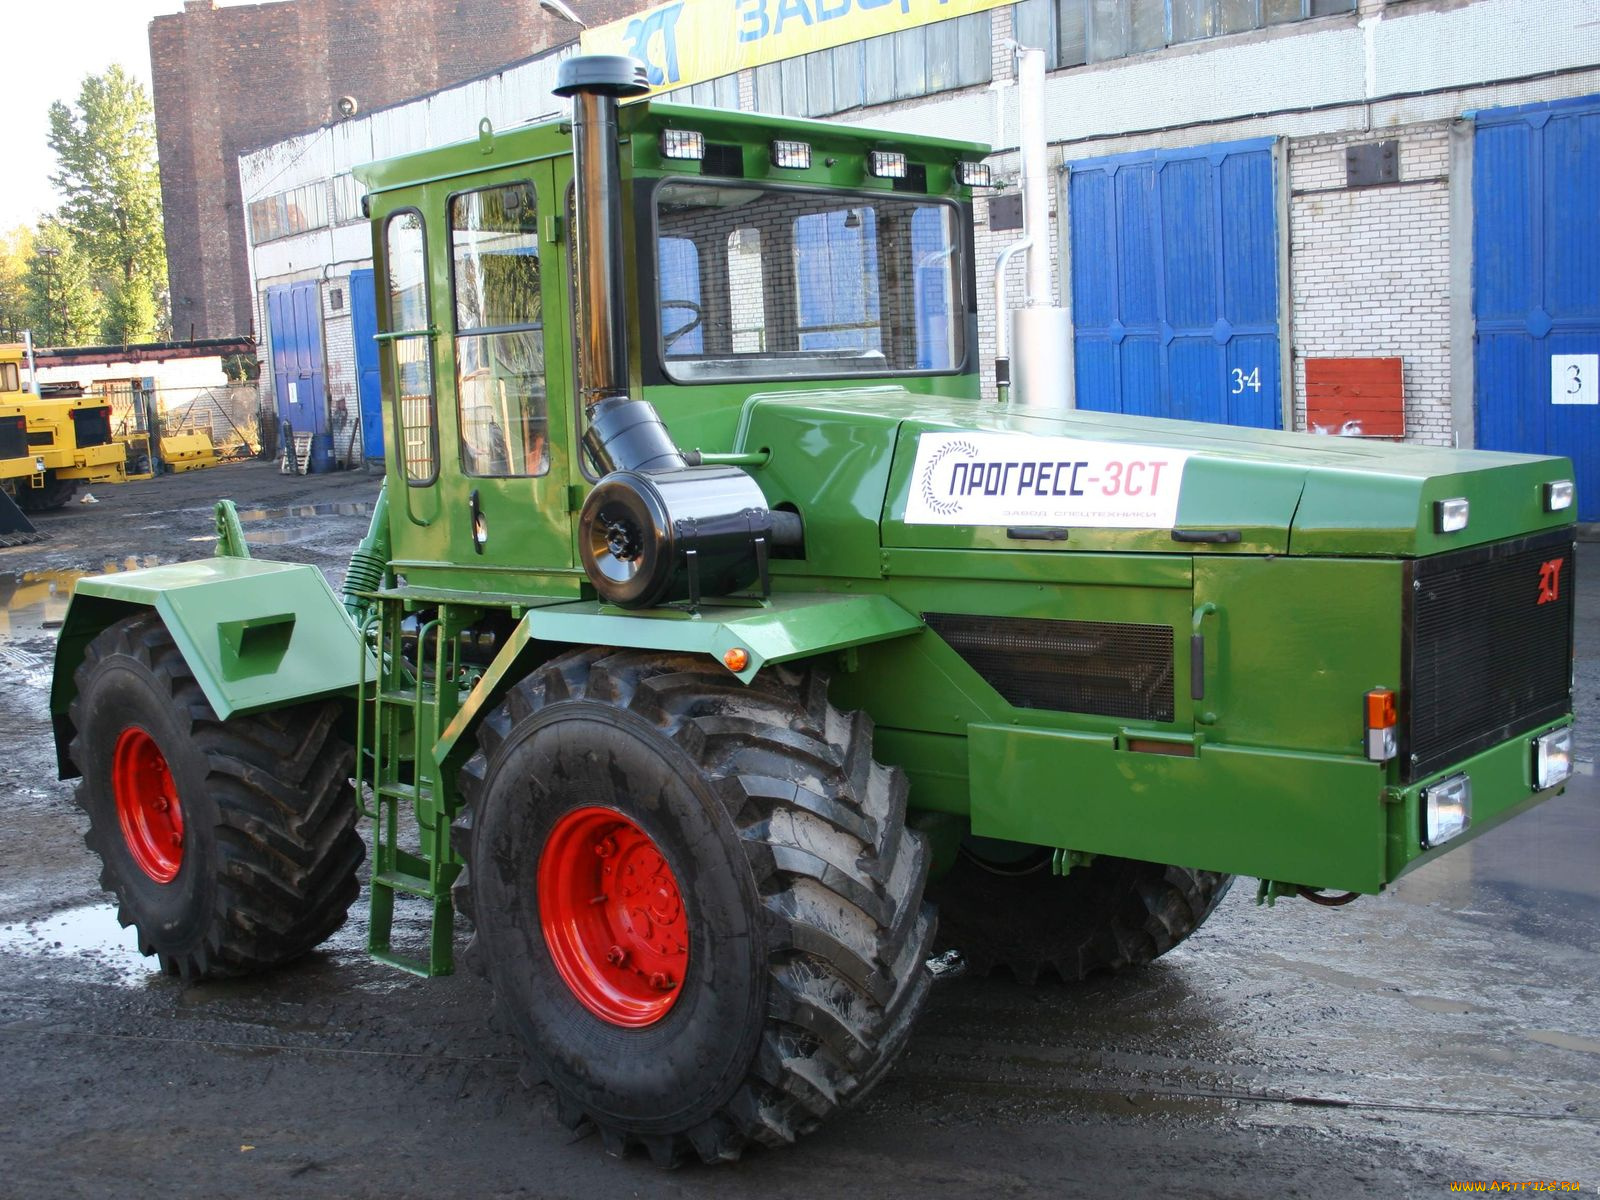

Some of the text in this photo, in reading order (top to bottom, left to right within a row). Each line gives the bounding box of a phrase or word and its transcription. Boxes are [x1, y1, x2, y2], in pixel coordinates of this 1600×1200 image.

[1231, 367, 1261, 394] 3-4
[1566, 365, 1582, 394] 3
[949, 461, 1168, 496] ПРОГРЕСС-ЗСТ
[1002, 510, 1047, 518] ЗАВОД
[1054, 510, 1157, 518] СПЕЦТЕХНИКИ
